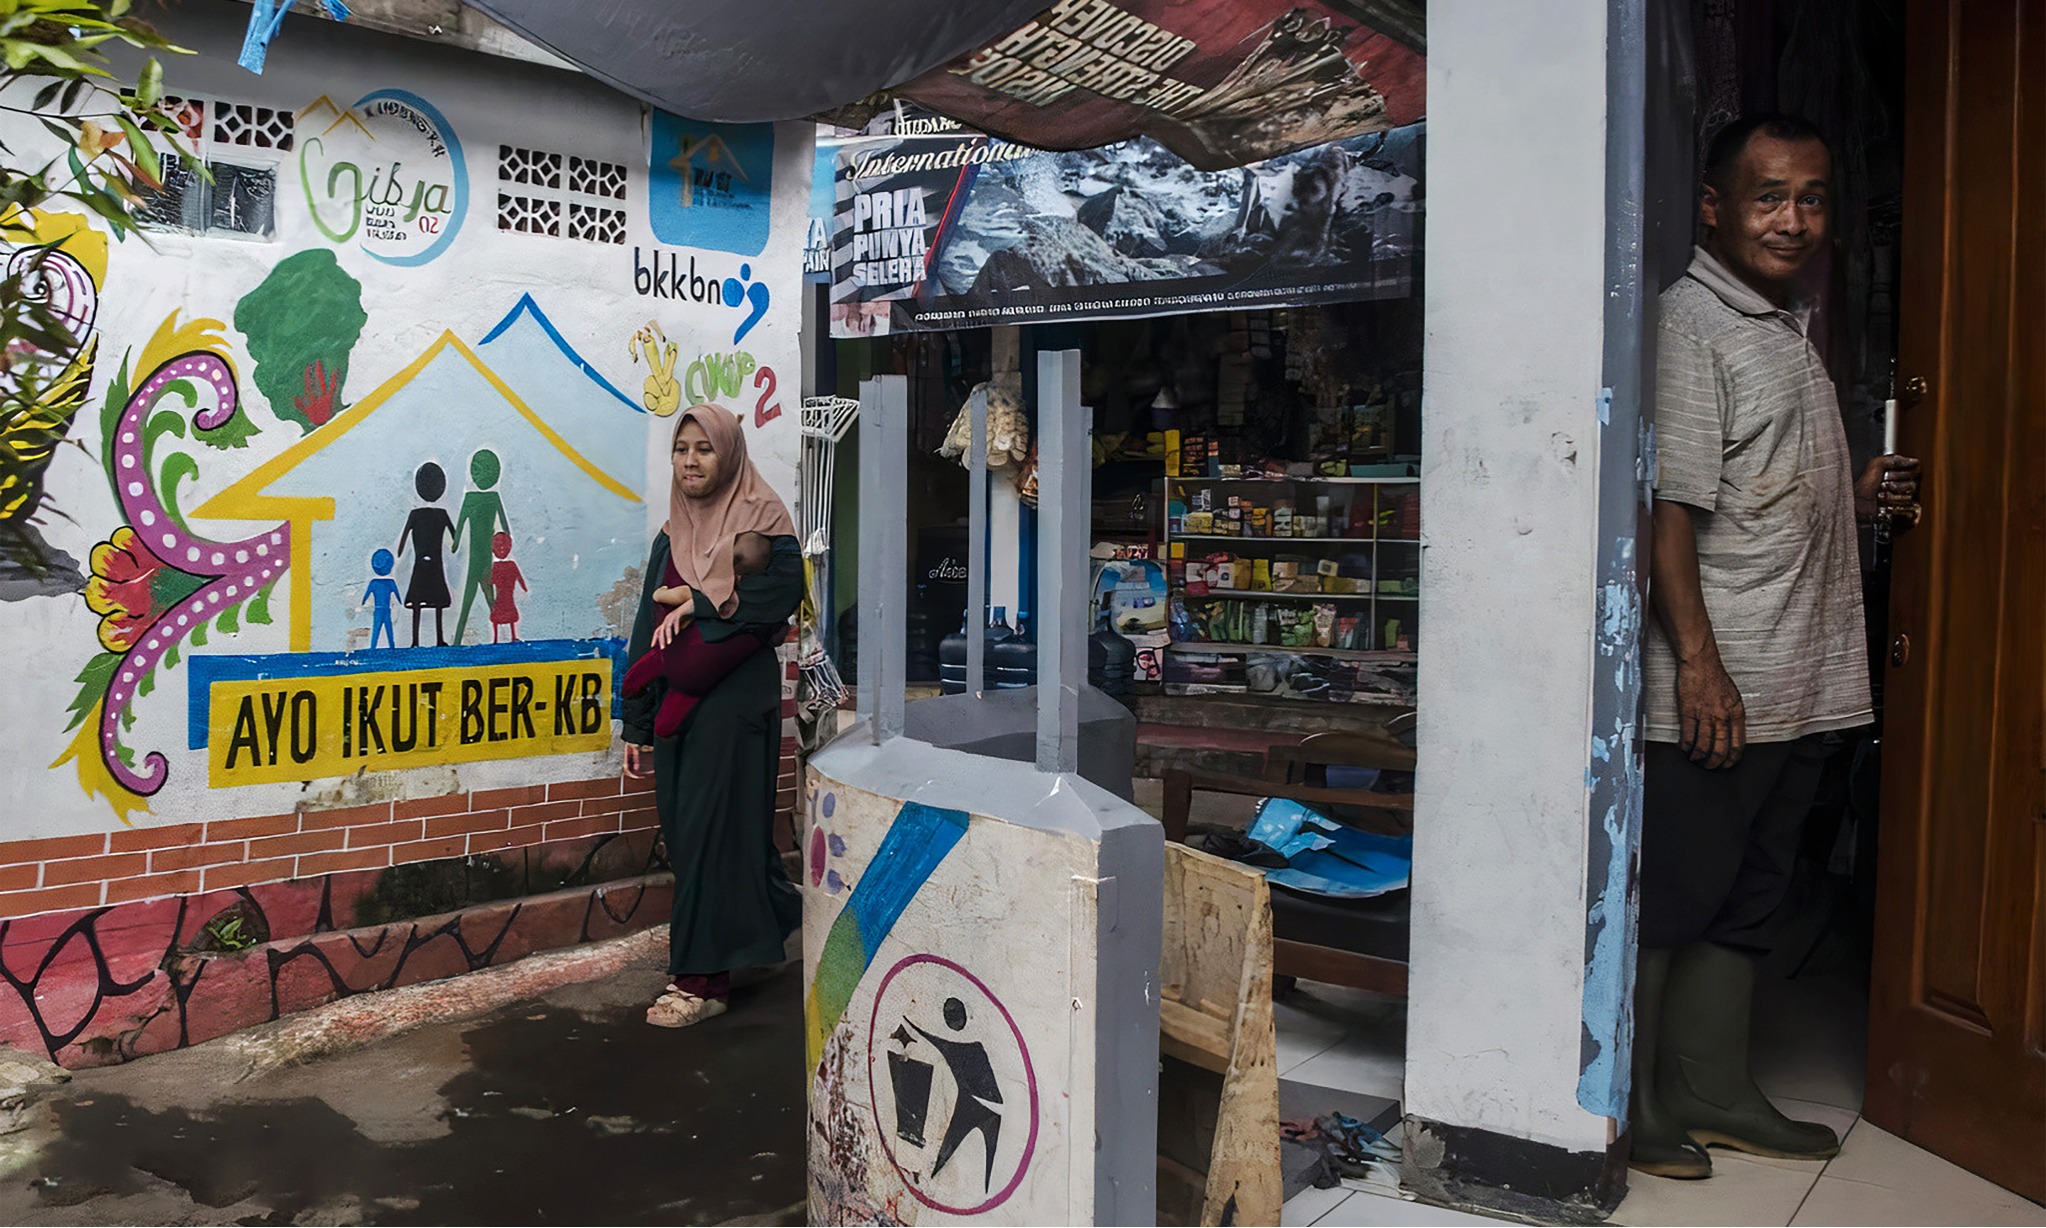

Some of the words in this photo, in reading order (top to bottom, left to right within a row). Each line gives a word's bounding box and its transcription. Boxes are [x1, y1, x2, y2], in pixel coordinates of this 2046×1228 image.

[854, 187, 927, 232] PRIA
[853, 228, 928, 261] PUNYA
[753, 366, 782, 429] 2
[225, 688, 319, 770] AYO
[342, 680, 444, 759] IKUT
[459, 672, 604, 746] BER-KB
